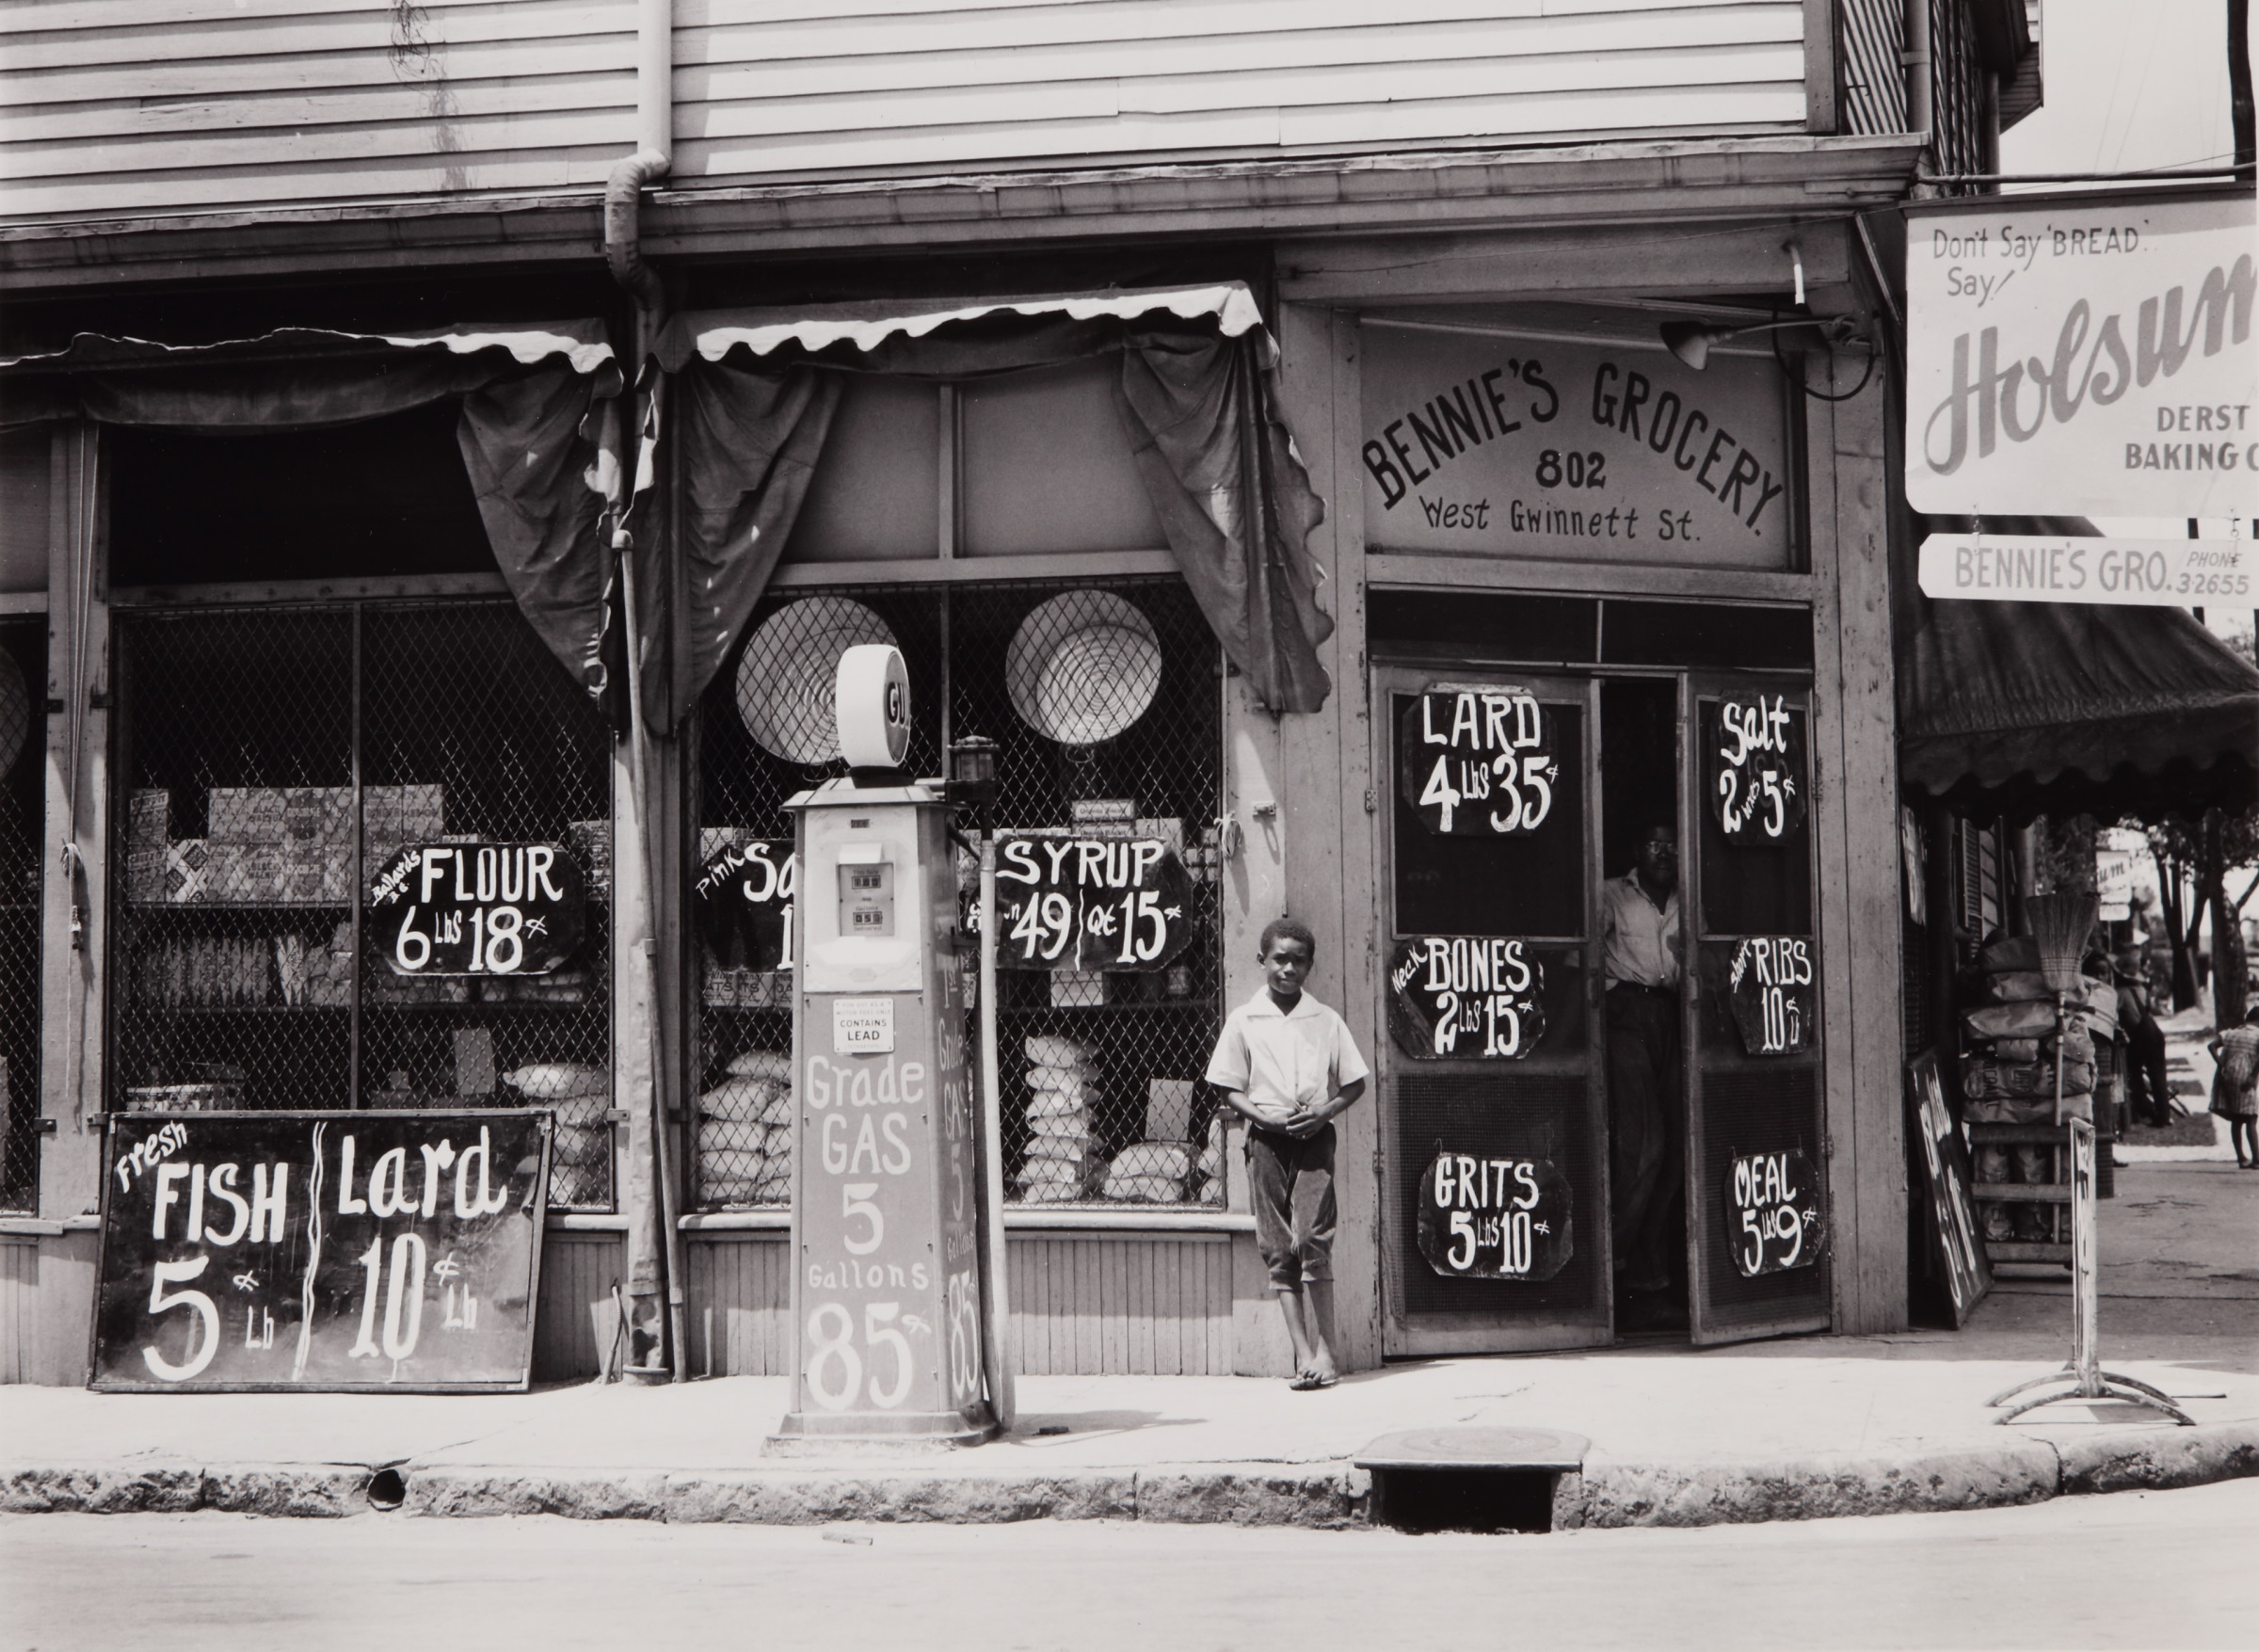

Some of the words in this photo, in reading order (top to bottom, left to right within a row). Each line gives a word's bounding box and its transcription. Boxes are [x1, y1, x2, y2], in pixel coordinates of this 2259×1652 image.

[1933, 228, 1989, 259] Don't
[2000, 225, 2042, 272] Say
[1924, 252, 2257, 476] Holsum
[1361, 358, 1560, 511] BENNIE'S
[2156, 405, 2251, 432] DERST
[1534, 448, 1608, 489] 802
[2123, 441, 2239, 472] BAKING
[1418, 495, 1491, 530] West
[1658, 508, 1702, 542] St.
[1954, 539, 2088, 591] BENNIE'S
[2098, 550, 2172, 593] GRO.
[2187, 551, 2243, 569] PHONE
[1423, 693, 1542, 757] LARD
[1720, 694, 1790, 767] Salt
[1418, 754, 1462, 833] 4
[1719, 768, 1741, 834] 2
[421, 845, 564, 904] FLOUR
[995, 840, 1165, 889] SYRUP
[395, 905, 431, 970] 6
[1423, 938, 1531, 993] BONES
[1751, 937, 1813, 986] RIBS
[840, 1018, 888, 1028] CONTAINS
[847, 1030, 881, 1041] LEAD
[1434, 990, 1460, 1055] 2
[807, 1054, 925, 1111] Grade
[116, 1119, 190, 1194] Fresh
[337, 1125, 508, 1220] Lard
[822, 1113, 912, 1176] GAS
[152, 1162, 289, 1247] FISH
[951, 1142, 964, 1222] 5
[1434, 1155, 1540, 1211] GRITS
[1734, 1152, 1797, 1209] MEAL
[842, 1182, 885, 1256] 5
[1447, 1210, 1477, 1271] 5
[1741, 1208, 1764, 1275] 5
[808, 1260, 930, 1291] Gallons
